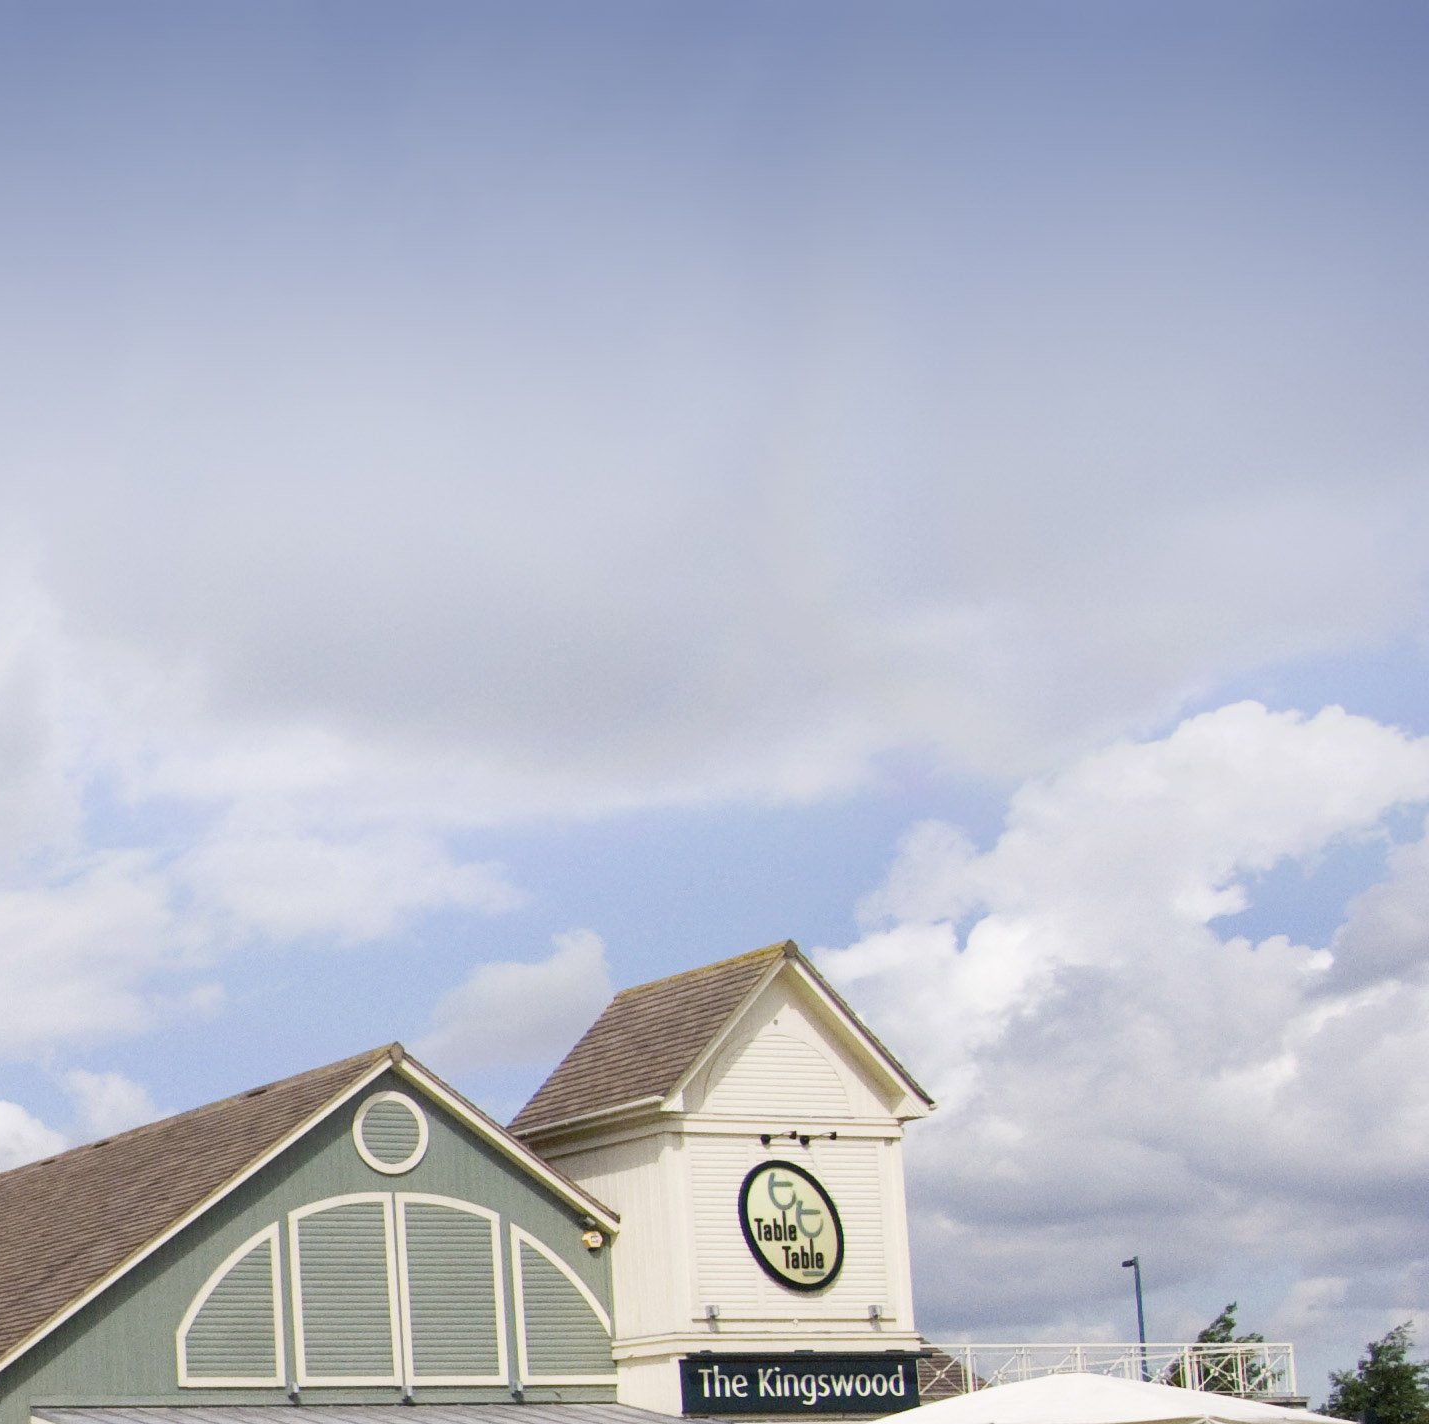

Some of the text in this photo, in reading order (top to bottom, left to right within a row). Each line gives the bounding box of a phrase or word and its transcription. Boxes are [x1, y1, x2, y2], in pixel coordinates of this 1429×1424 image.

[754, 1211, 797, 1242] Table
[782, 1238, 824, 1270] Table
[698, 1365, 905, 1406] The Kingswood
